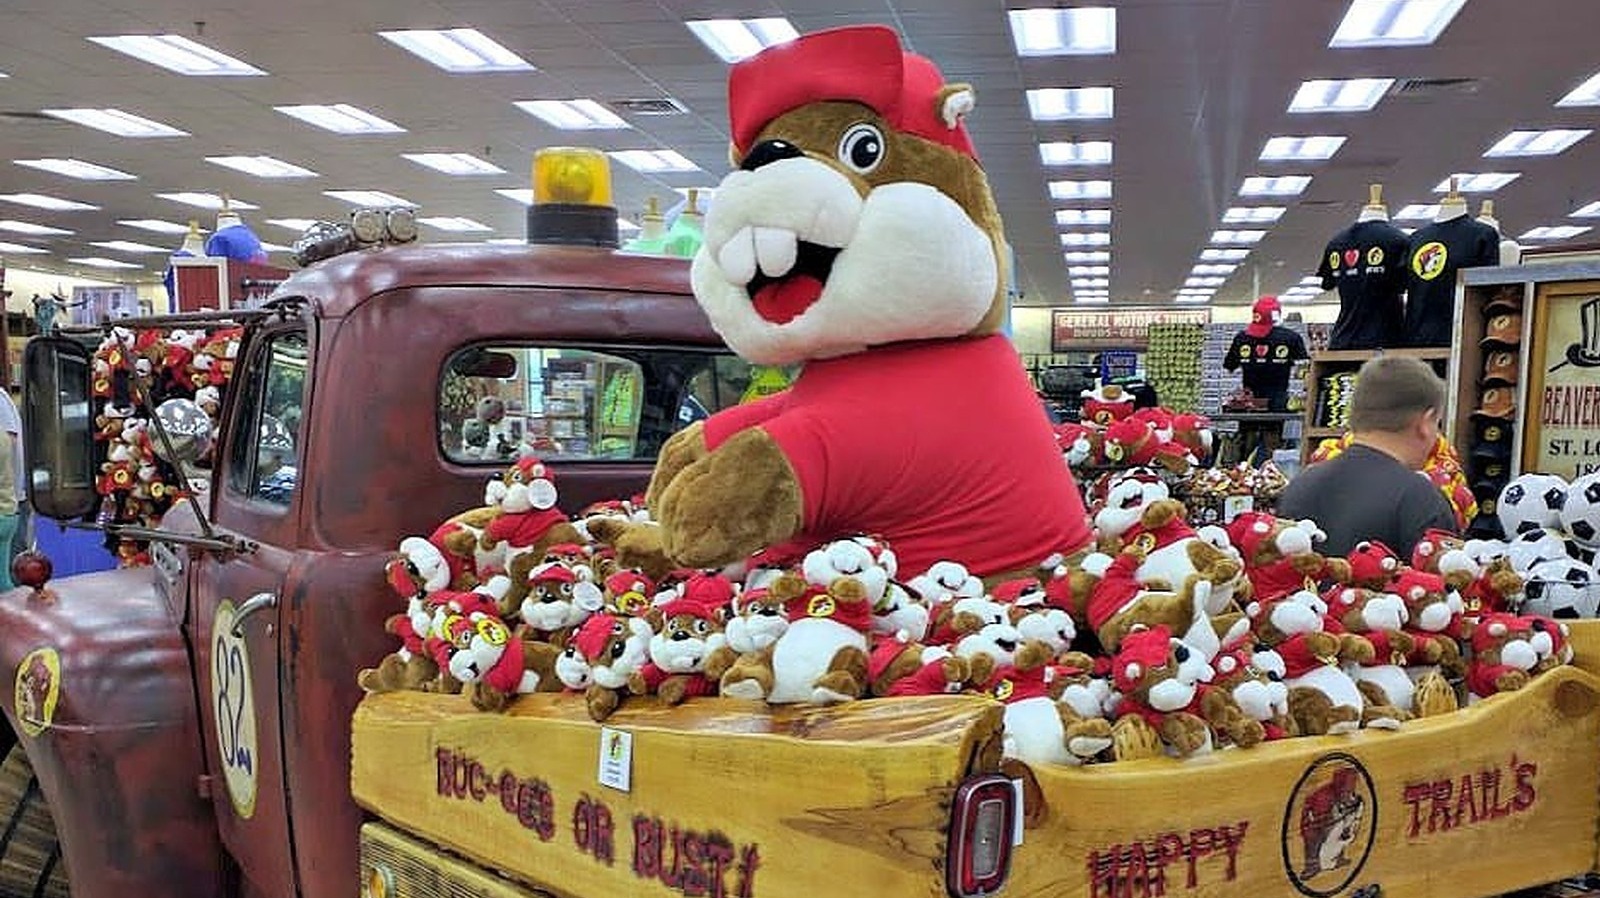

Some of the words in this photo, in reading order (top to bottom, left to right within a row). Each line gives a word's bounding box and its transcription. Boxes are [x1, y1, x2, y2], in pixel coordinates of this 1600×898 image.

[1059, 315, 1111, 328] GENERAL
[1113, 313, 1162, 328] MOTORS
[1548, 438, 1578, 456] ST.
[216, 635, 253, 777] 82
[573, 795, 616, 868] OR
[1085, 820, 1249, 898] HAPPY
